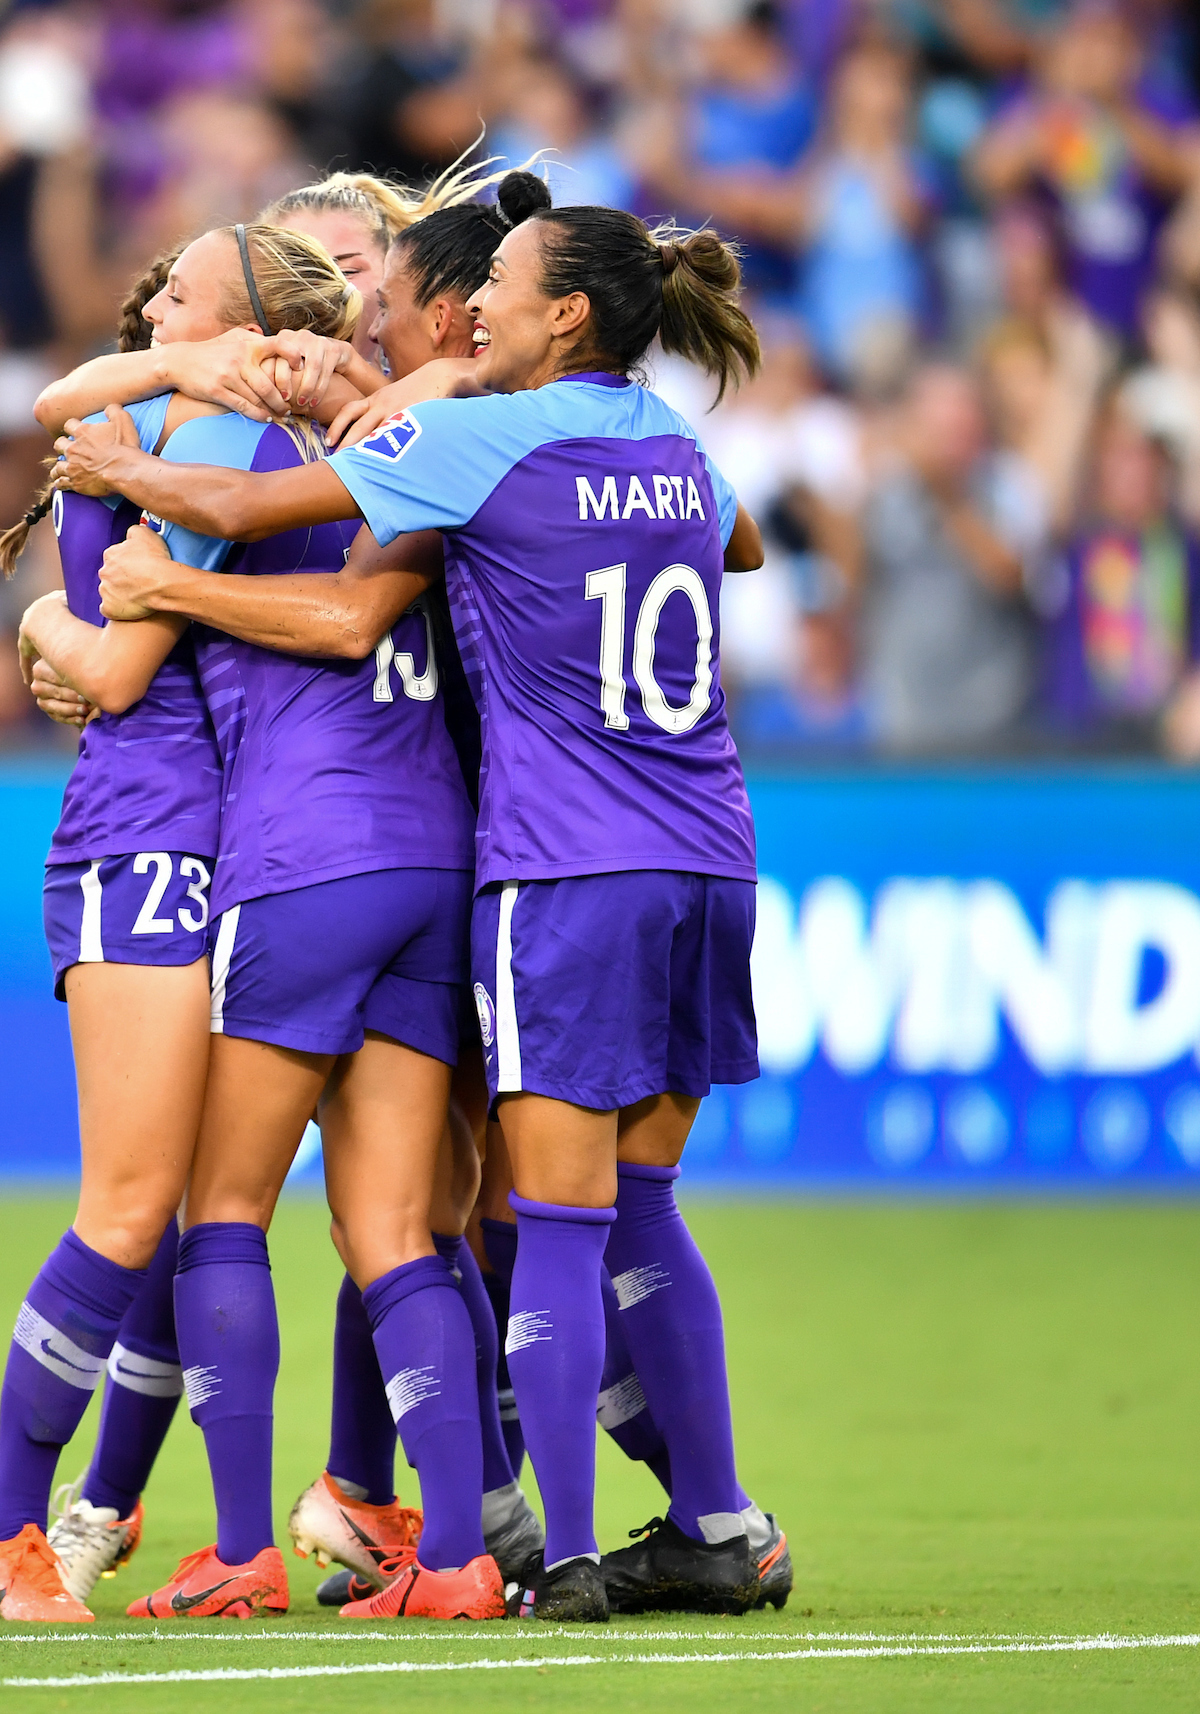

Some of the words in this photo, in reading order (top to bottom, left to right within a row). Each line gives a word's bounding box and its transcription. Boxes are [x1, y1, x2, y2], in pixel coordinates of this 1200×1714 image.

[575, 474, 706, 521] MARTA
[584, 562, 714, 735] 10
[130, 852, 211, 935] 23
